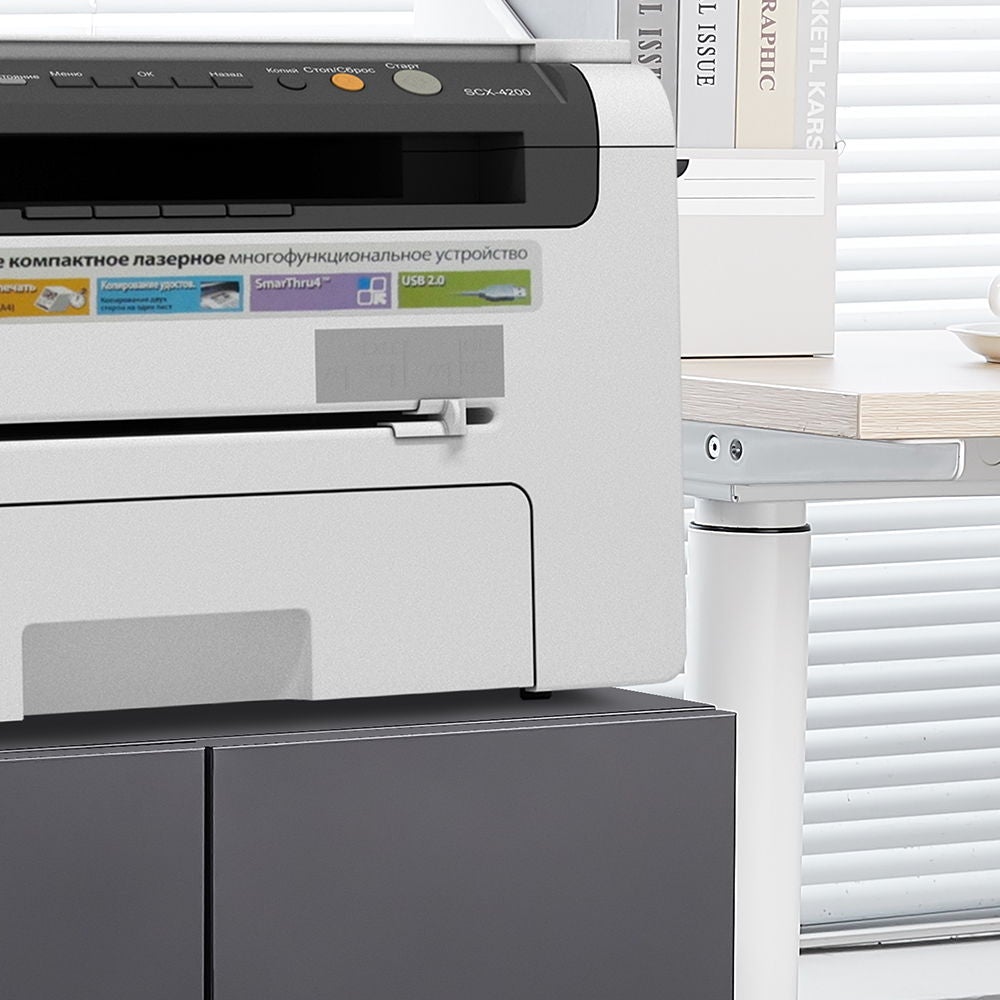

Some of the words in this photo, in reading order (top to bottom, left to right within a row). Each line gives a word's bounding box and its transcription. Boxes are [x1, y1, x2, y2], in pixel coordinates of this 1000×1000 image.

[696, 24, 717, 87] ISSUE
[303, 66, 376, 75] Стоп/Сброс
[385, 62, 420, 71] Старт
[50, 70, 83, 78] Меню
[209, 71, 244, 79] Назад
[463, 88, 532, 97] SCX-4200
[9, 252, 129, 268] компактное
[132, 251, 226, 270] лазерное
[228, 246, 431, 268] многофункциональное
[434, 244, 529, 264] устройство
[401, 275, 425, 286] USB
[427, 275, 445, 286] 2.0
